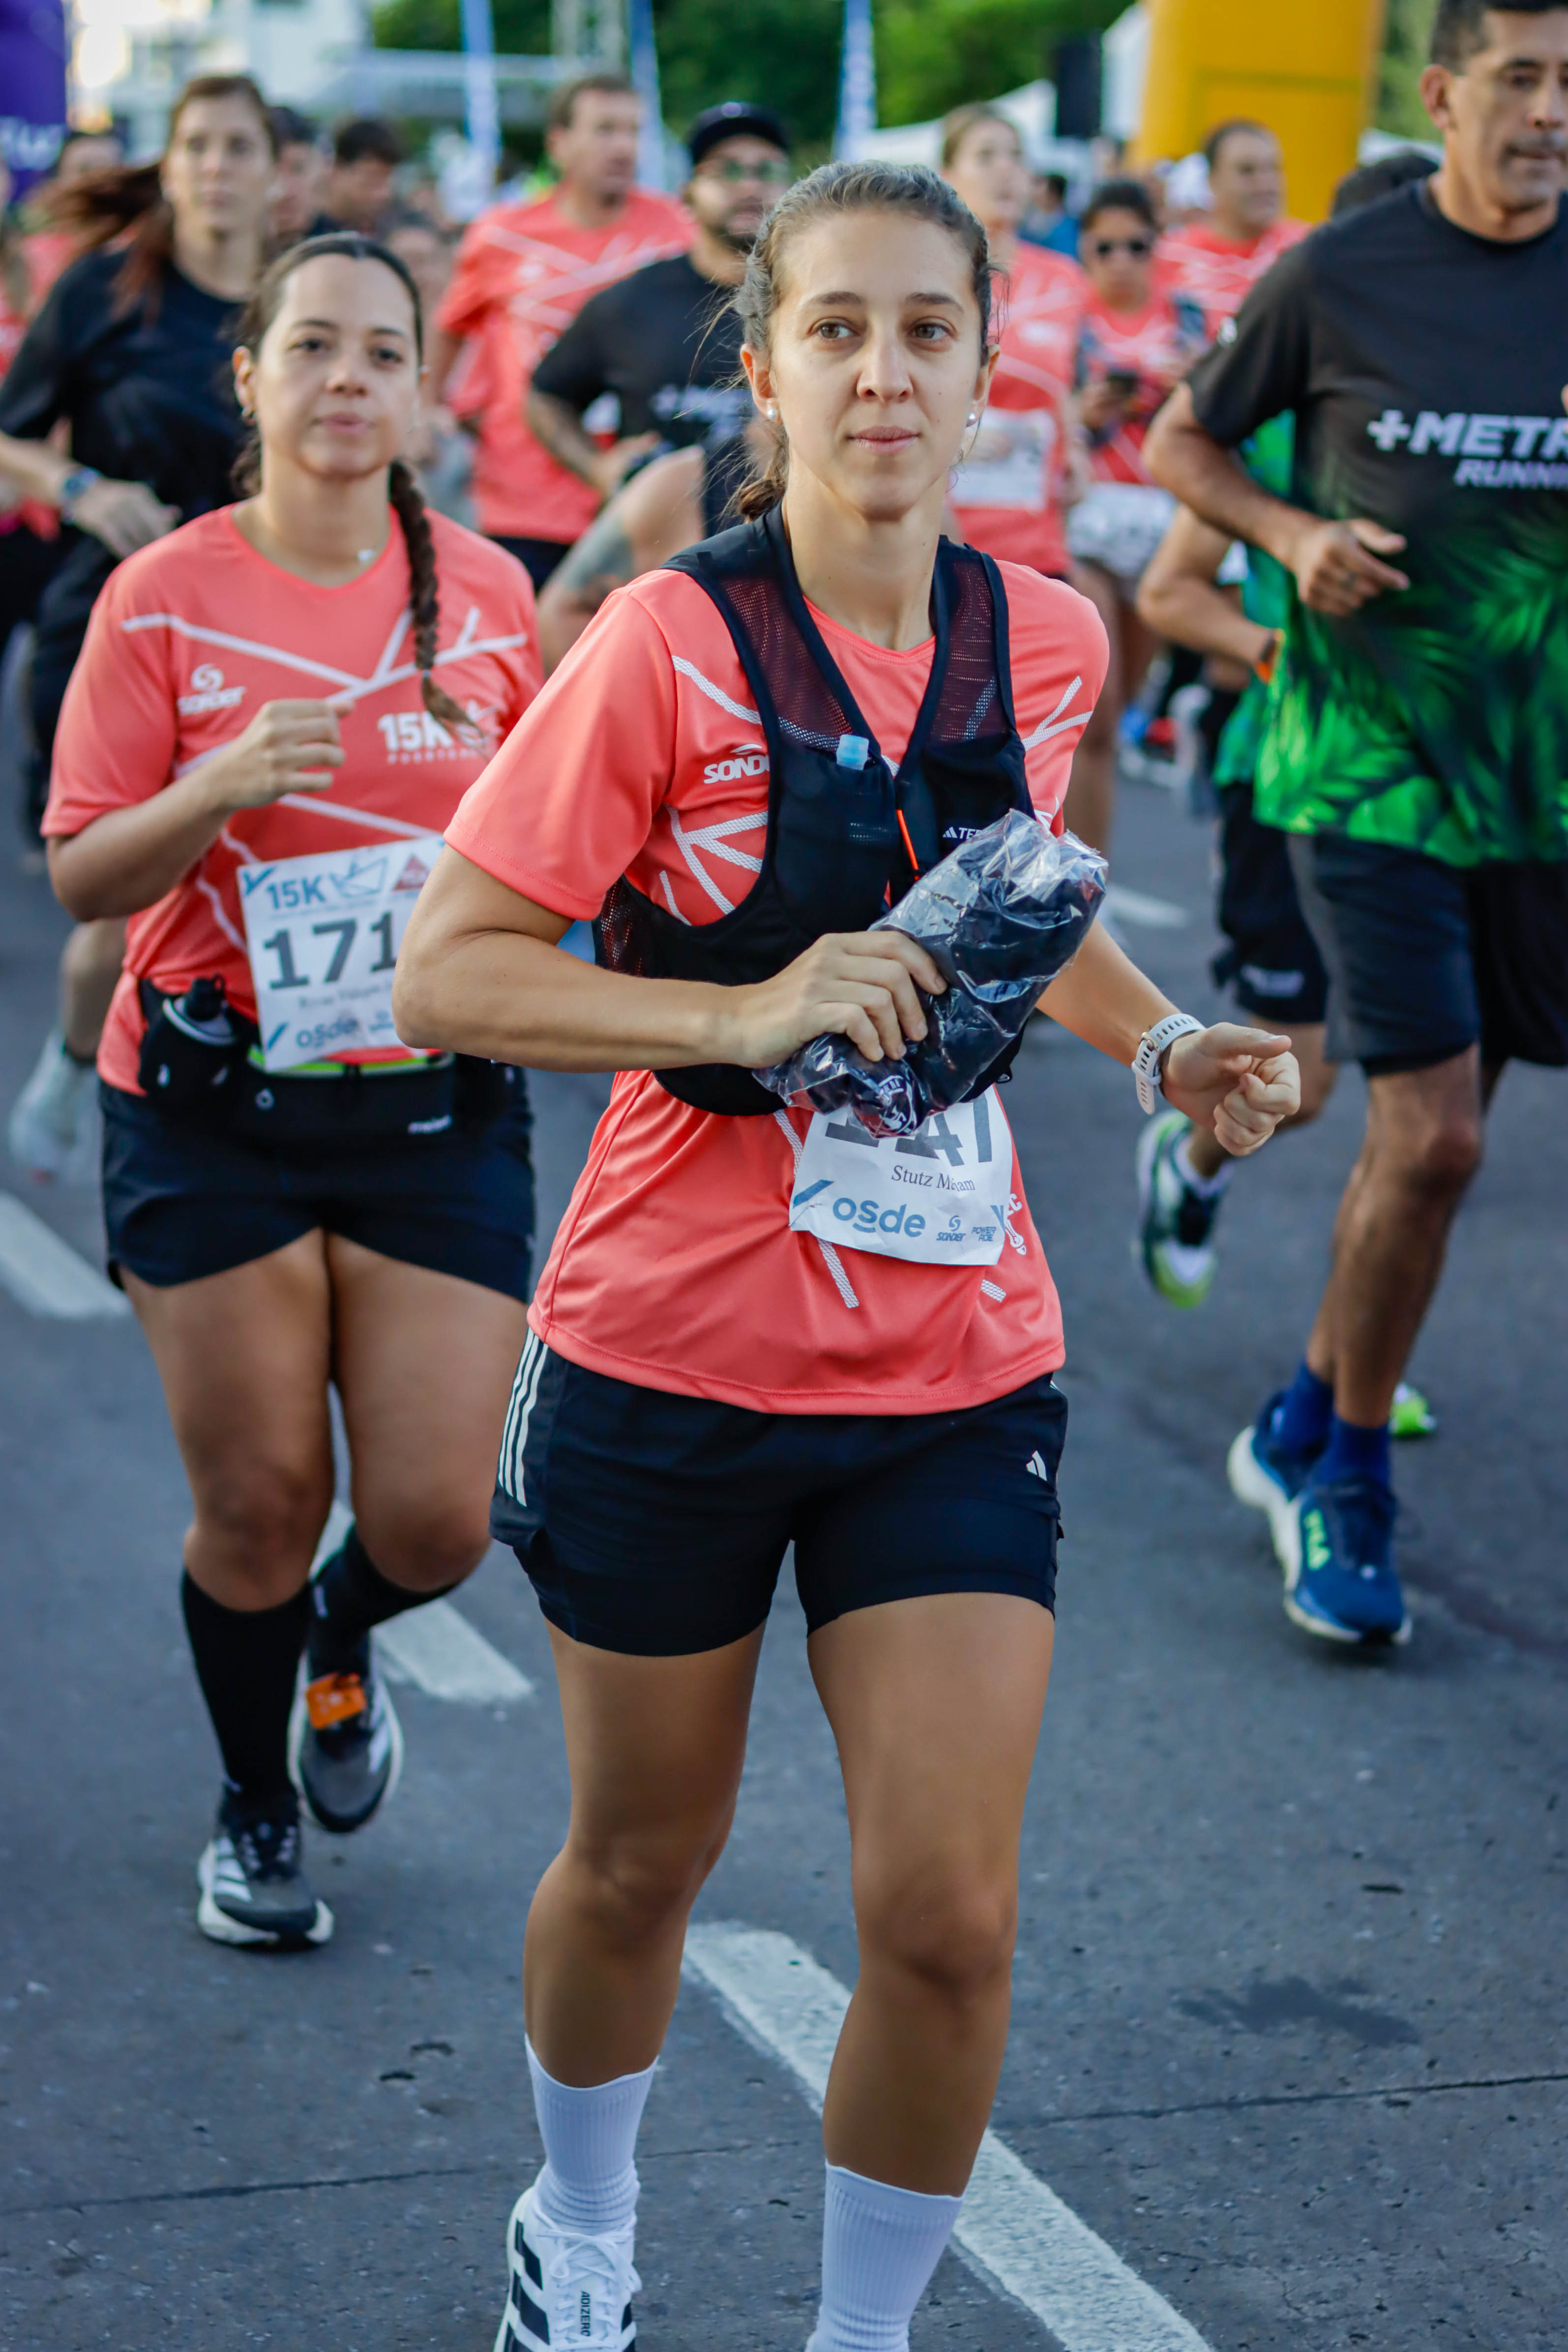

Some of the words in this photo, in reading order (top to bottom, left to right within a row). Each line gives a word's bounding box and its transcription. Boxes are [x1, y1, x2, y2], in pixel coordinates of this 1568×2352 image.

[266, 874, 326, 909] 15K
[891, 1165, 934, 1187] Stutz
[832, 1197, 926, 1237] osde
[971, 1226, 997, 1235] POWER
